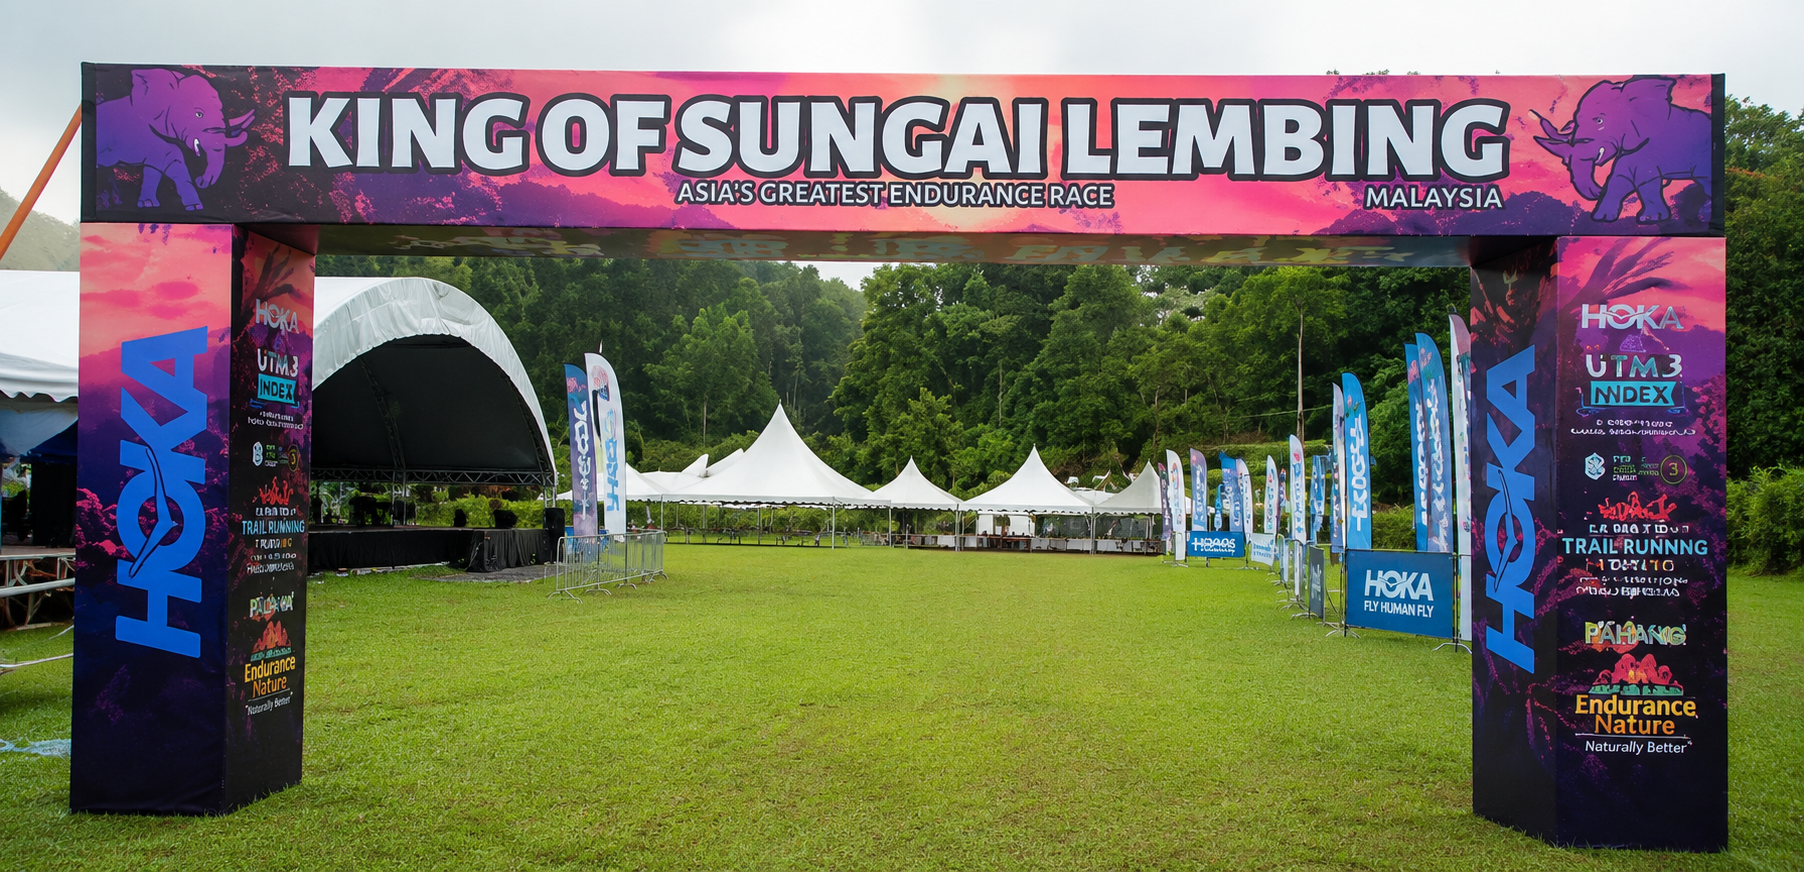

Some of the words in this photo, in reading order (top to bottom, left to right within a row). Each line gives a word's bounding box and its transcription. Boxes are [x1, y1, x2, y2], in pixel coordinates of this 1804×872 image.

[286, 95, 528, 173] KING
[540, 96, 669, 174] OF
[677, 98, 1044, 176] SUNGAI
[1064, 102, 1506, 179] LEMBING
[677, 181, 755, 204] ASIA'S
[757, 182, 886, 205] GREATEST
[889, 183, 1044, 206] ENDURANCE
[1048, 185, 1114, 207] RACE
[1364, 186, 1504, 210] MALAYSIA
[255, 298, 299, 335] HOKA
[1580, 303, 1685, 330] HOKA
[115, 326, 208, 659] HOKA
[1484, 344, 1536, 674] HOKA
[242, 520, 267, 535] TRAIL
[1562, 537, 1618, 555] TRAIL
[1364, 569, 1434, 602] HOKA
[1364, 600, 1379, 612] FLY
[1380, 602, 1416, 616] HUMAN
[1417, 605, 1434, 618] FLY
[244, 655, 296, 683] Endurance
[252, 676, 287, 698] Nature
[1575, 694, 1697, 717] Endurance
[1594, 714, 1676, 735] Nature
[1585, 740, 1644, 756] Naturally
